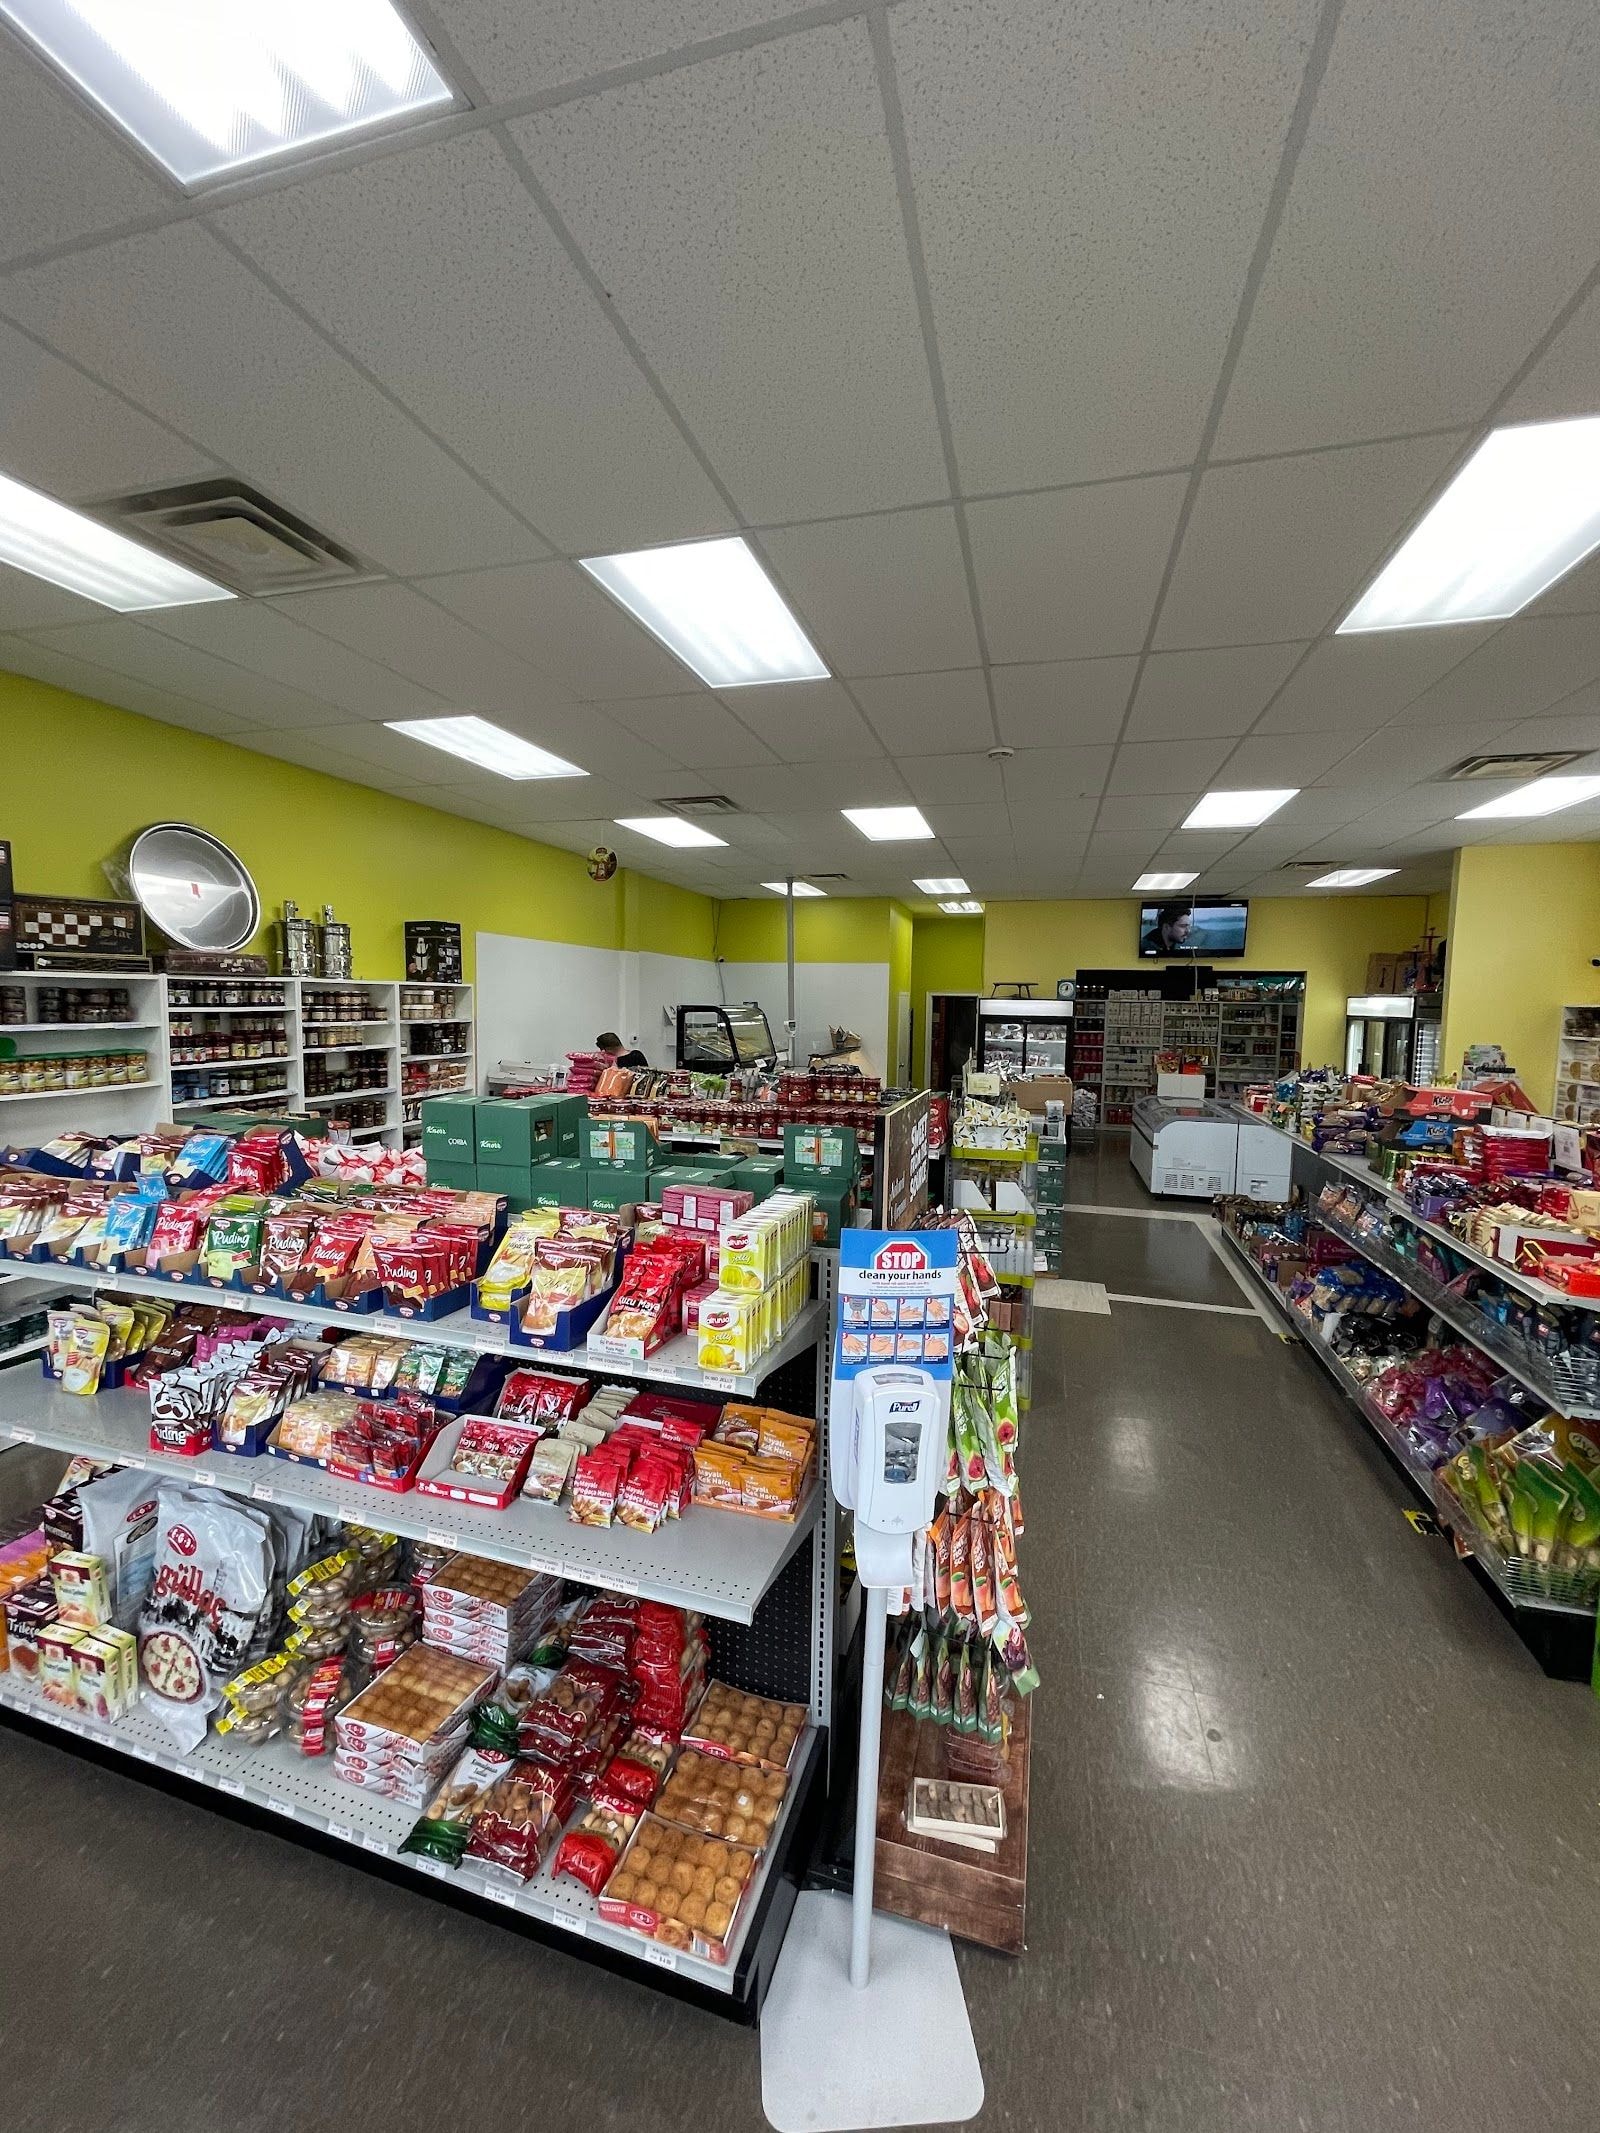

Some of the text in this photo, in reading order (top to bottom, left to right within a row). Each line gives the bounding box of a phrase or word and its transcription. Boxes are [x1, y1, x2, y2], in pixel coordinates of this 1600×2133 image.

[426, 1126, 447, 1135] Knorr
[480, 1140, 502, 1149] Knorr
[537, 1196, 559, 1206] Knorr
[592, 1199, 615, 1209] Knorr
[157, 1219, 193, 1234] Puding
[212, 1230, 250, 1248] Puding
[267, 1236, 304, 1252] Puding
[312, 1246, 347, 1261] Puding
[881, 1251, 921, 1269] STOP
[381, 1263, 418, 1284] Puding
[859, 1270, 942, 1282] clean your hands
[638, 1300, 660, 1311] Maya
[459, 1437, 476, 1448] Maya
[484, 1441, 500, 1451] Maya
[508, 1445, 526, 1456] Maya
